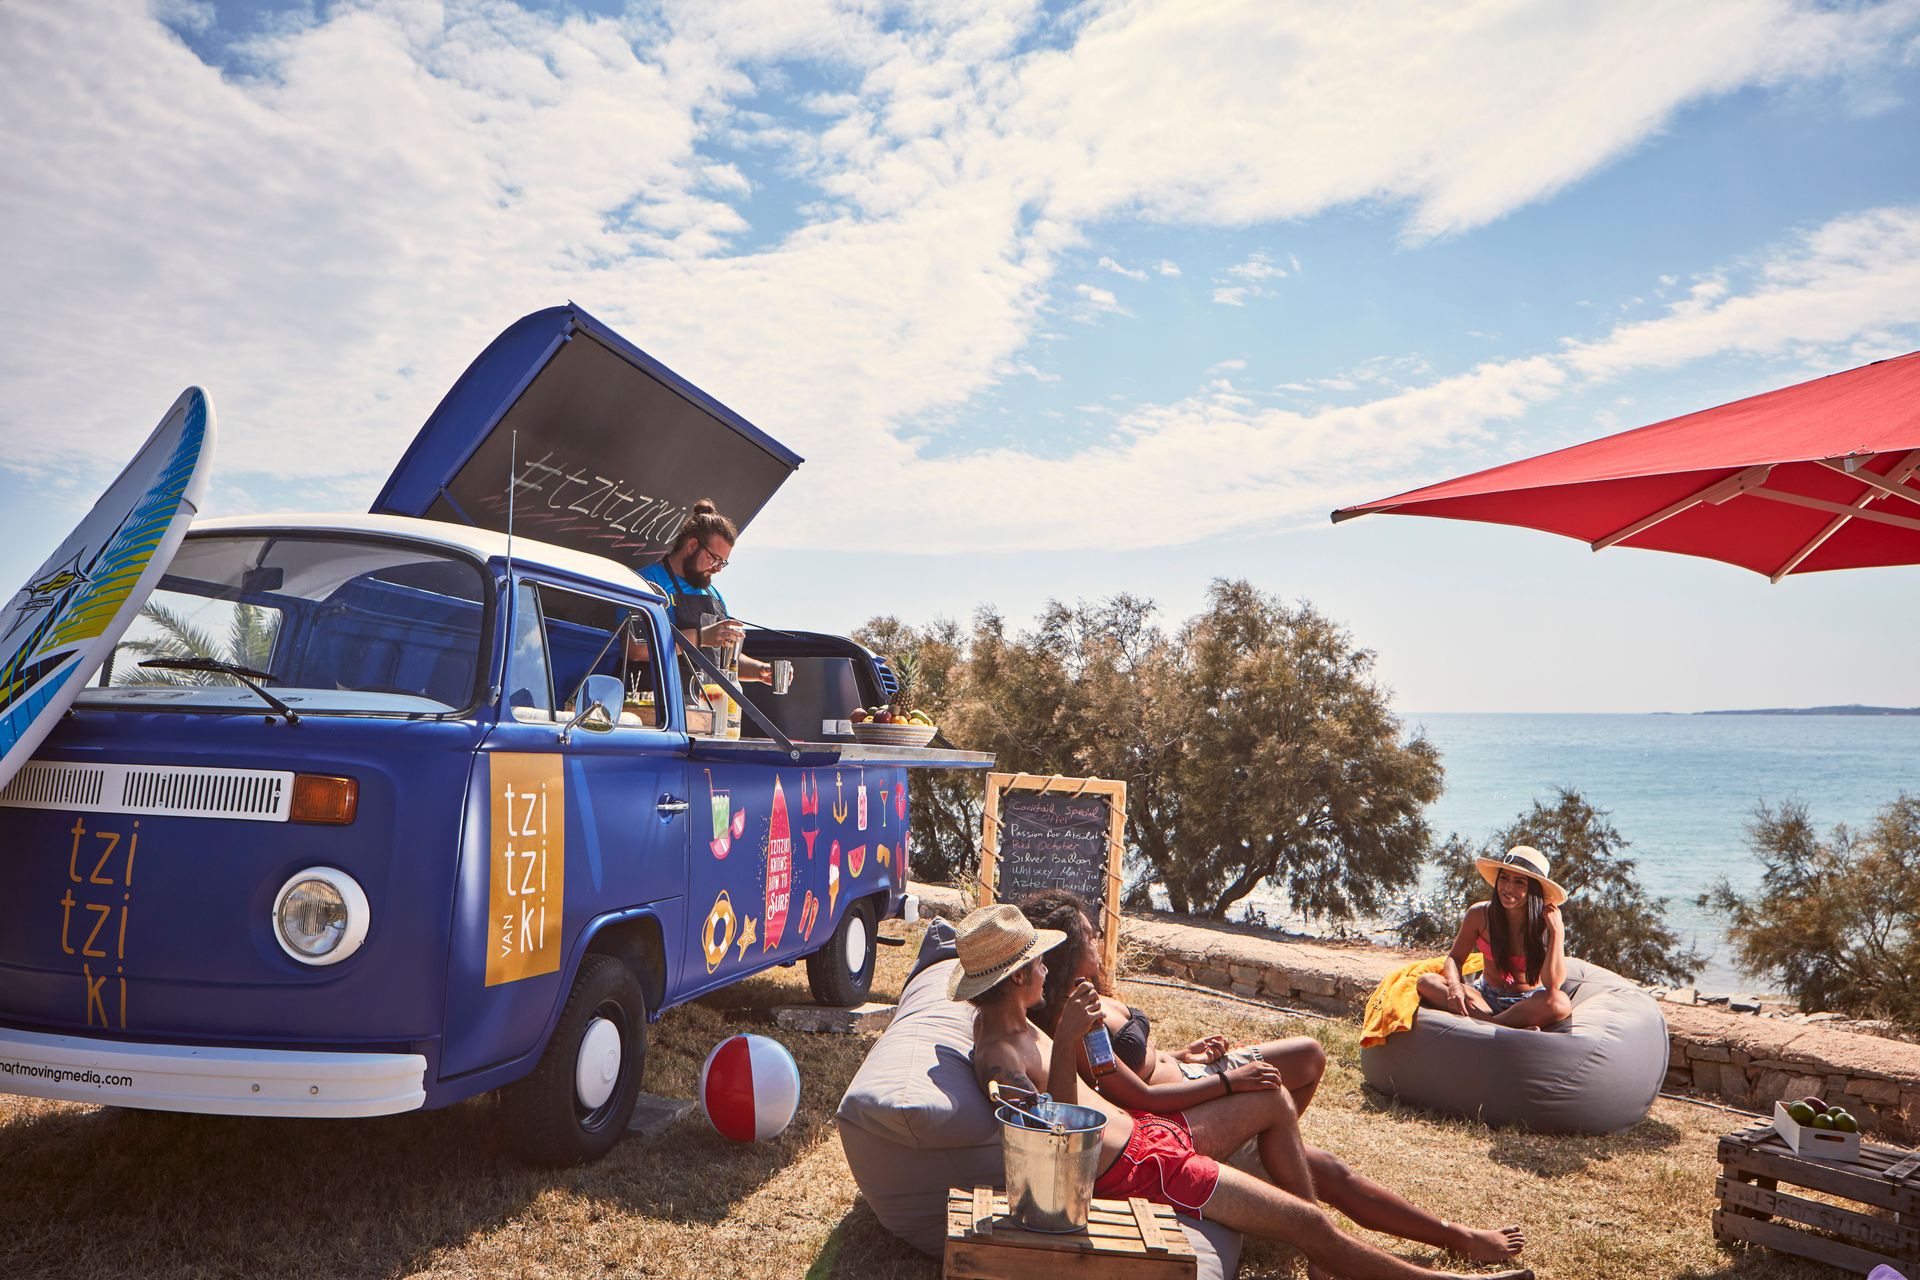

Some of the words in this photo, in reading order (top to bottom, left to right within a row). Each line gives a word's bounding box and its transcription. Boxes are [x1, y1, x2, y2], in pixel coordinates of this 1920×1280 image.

[505, 783, 547, 837] tzi
[1012, 801, 1056, 814] Cocktail
[1064, 806, 1099, 819] Special
[1011, 823, 1043, 838] Passion
[1046, 829, 1060, 838] for
[1012, 840, 1030, 850] Red
[1038, 840, 1080, 851] October
[70, 817, 140, 887] tzi
[1011, 851, 1046, 864] Silver
[1051, 852, 1091, 866] Balloon
[505, 840, 547, 896] tzi
[781, 873, 788, 889] TO
[1012, 865, 1053, 879] Whiskey
[1012, 877, 1048, 889] Aztec
[1052, 877, 1097, 892] Thunder
[60, 888, 130, 960] tzi
[501, 914, 514, 959] VAN
[520, 897, 545, 953] ki
[83, 963, 127, 1030] ki
